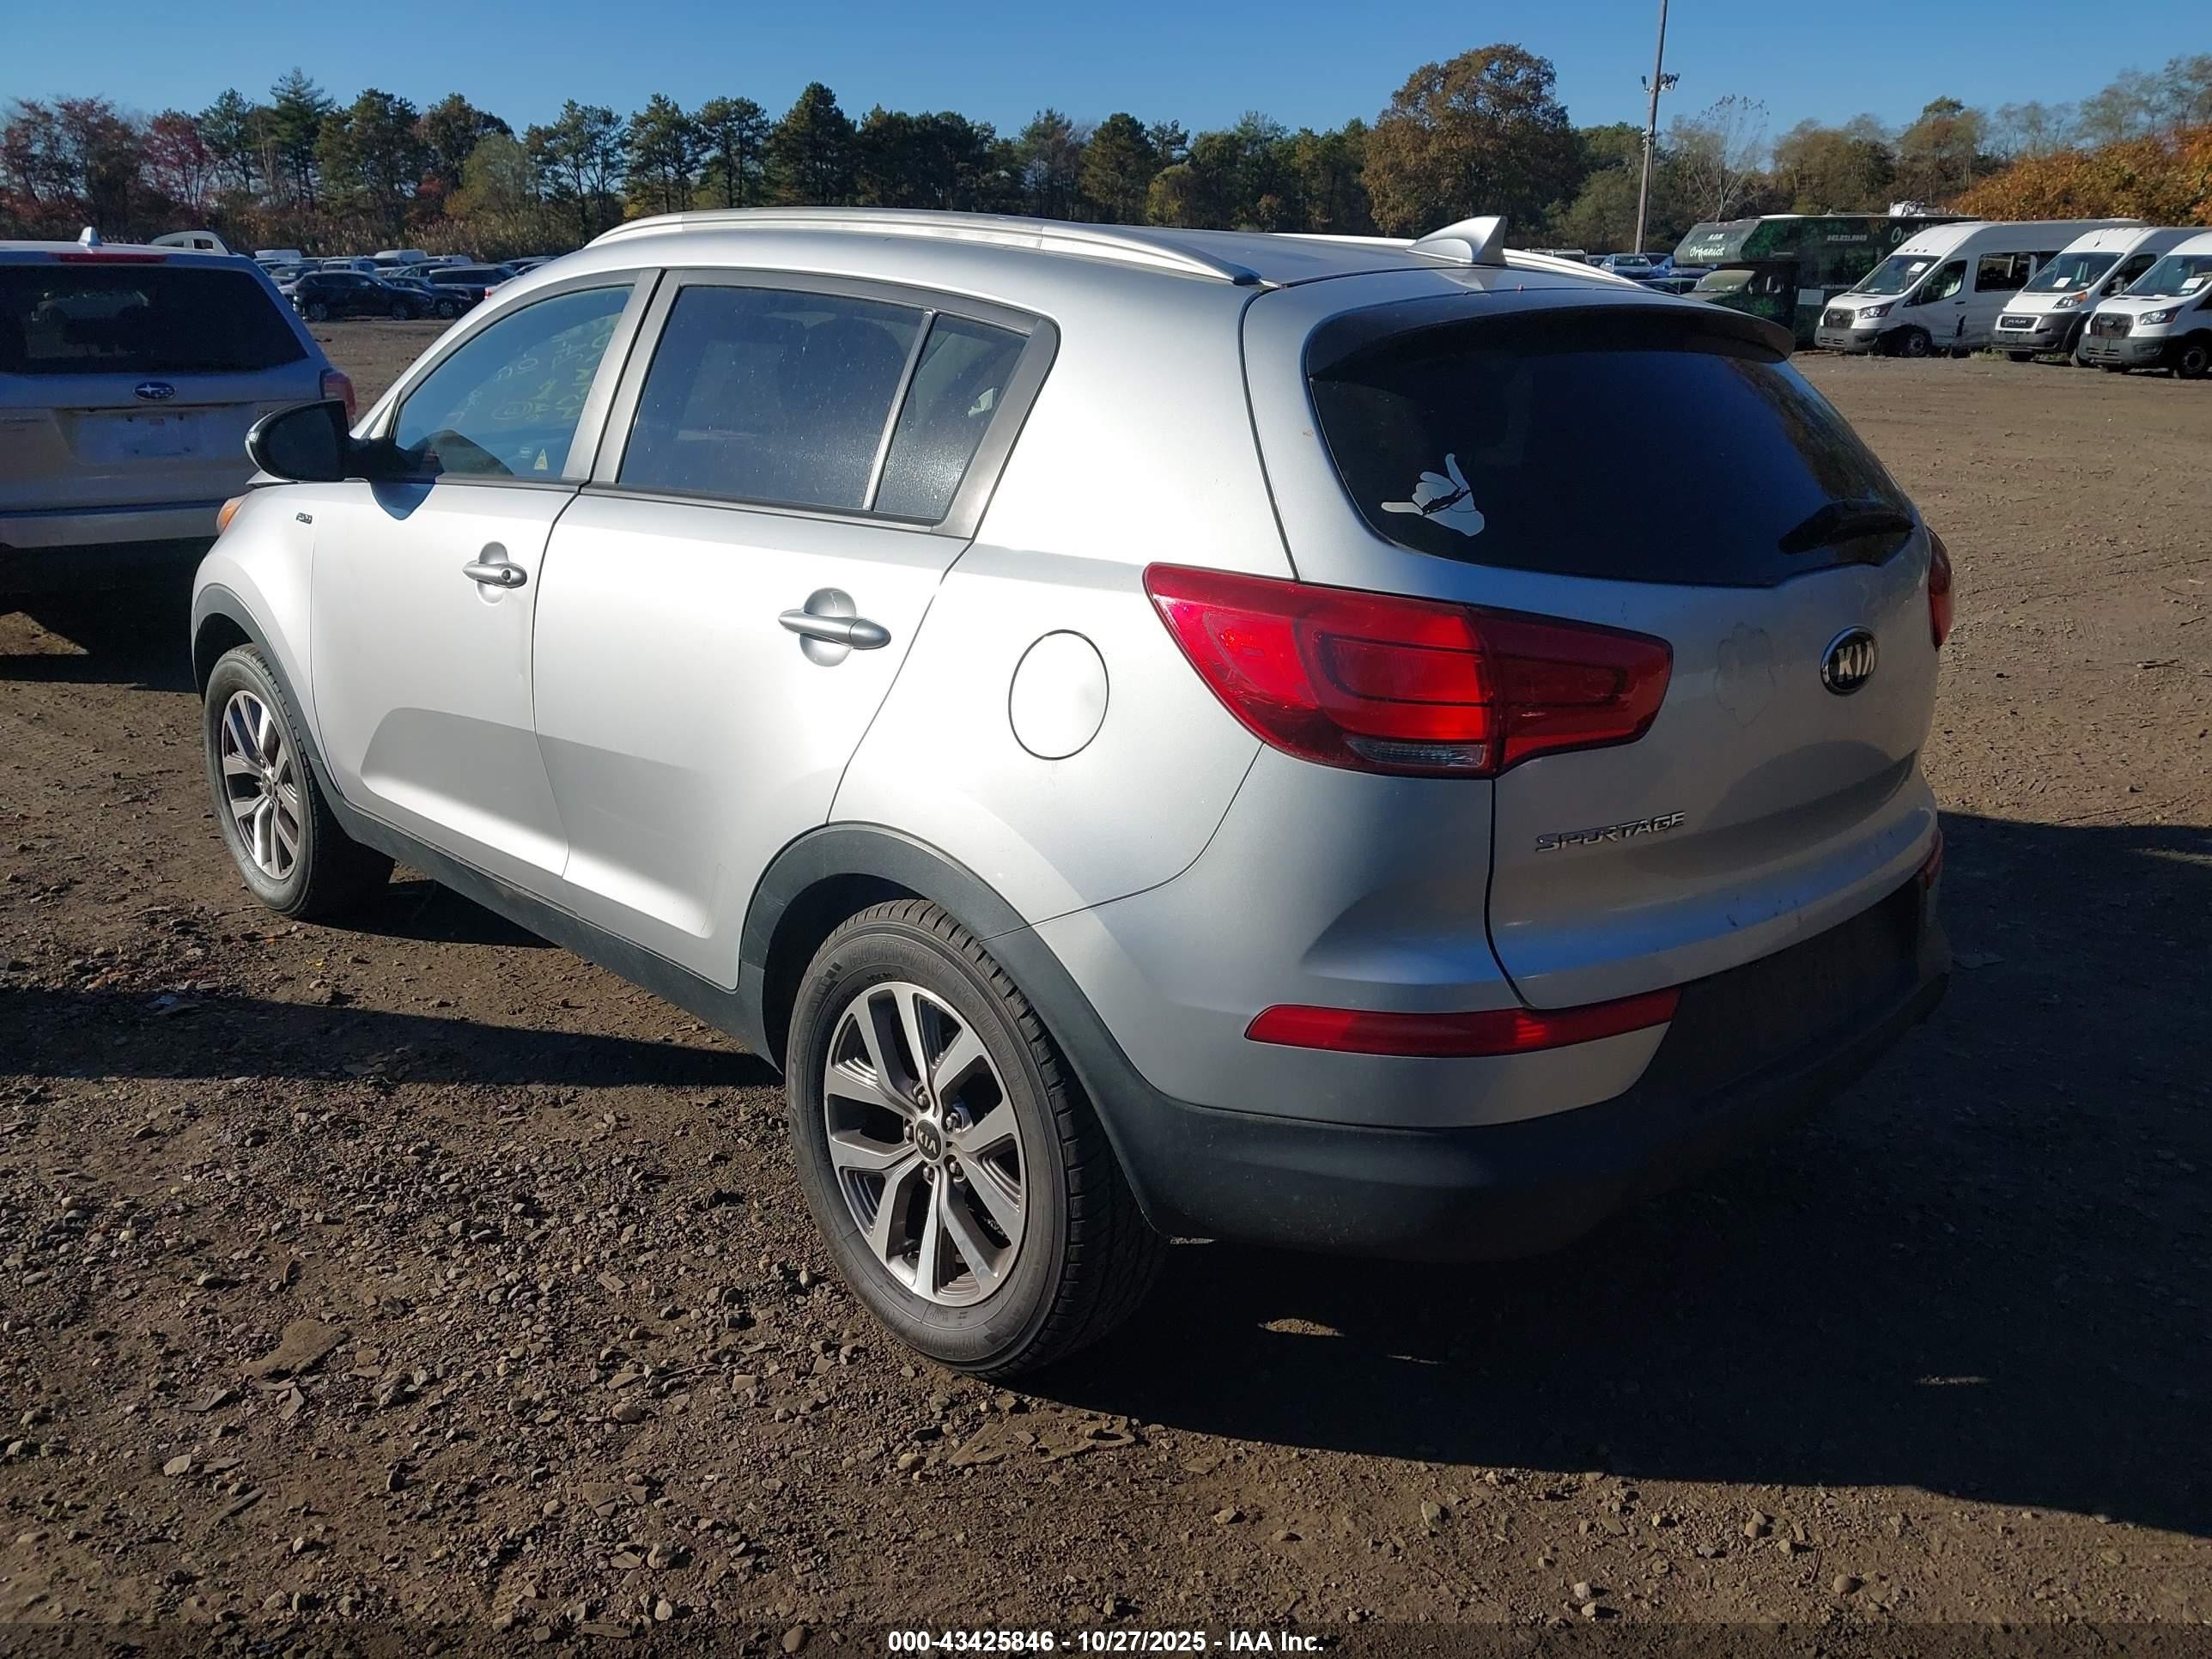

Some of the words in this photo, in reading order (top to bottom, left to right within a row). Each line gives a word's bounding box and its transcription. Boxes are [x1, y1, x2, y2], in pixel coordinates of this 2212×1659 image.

[1689, 245, 1725, 262] Organics
[1836, 641, 1875, 682] KIA
[1535, 810, 1686, 853] SPORTAGE
[916, 1127, 937, 1155] KIA
